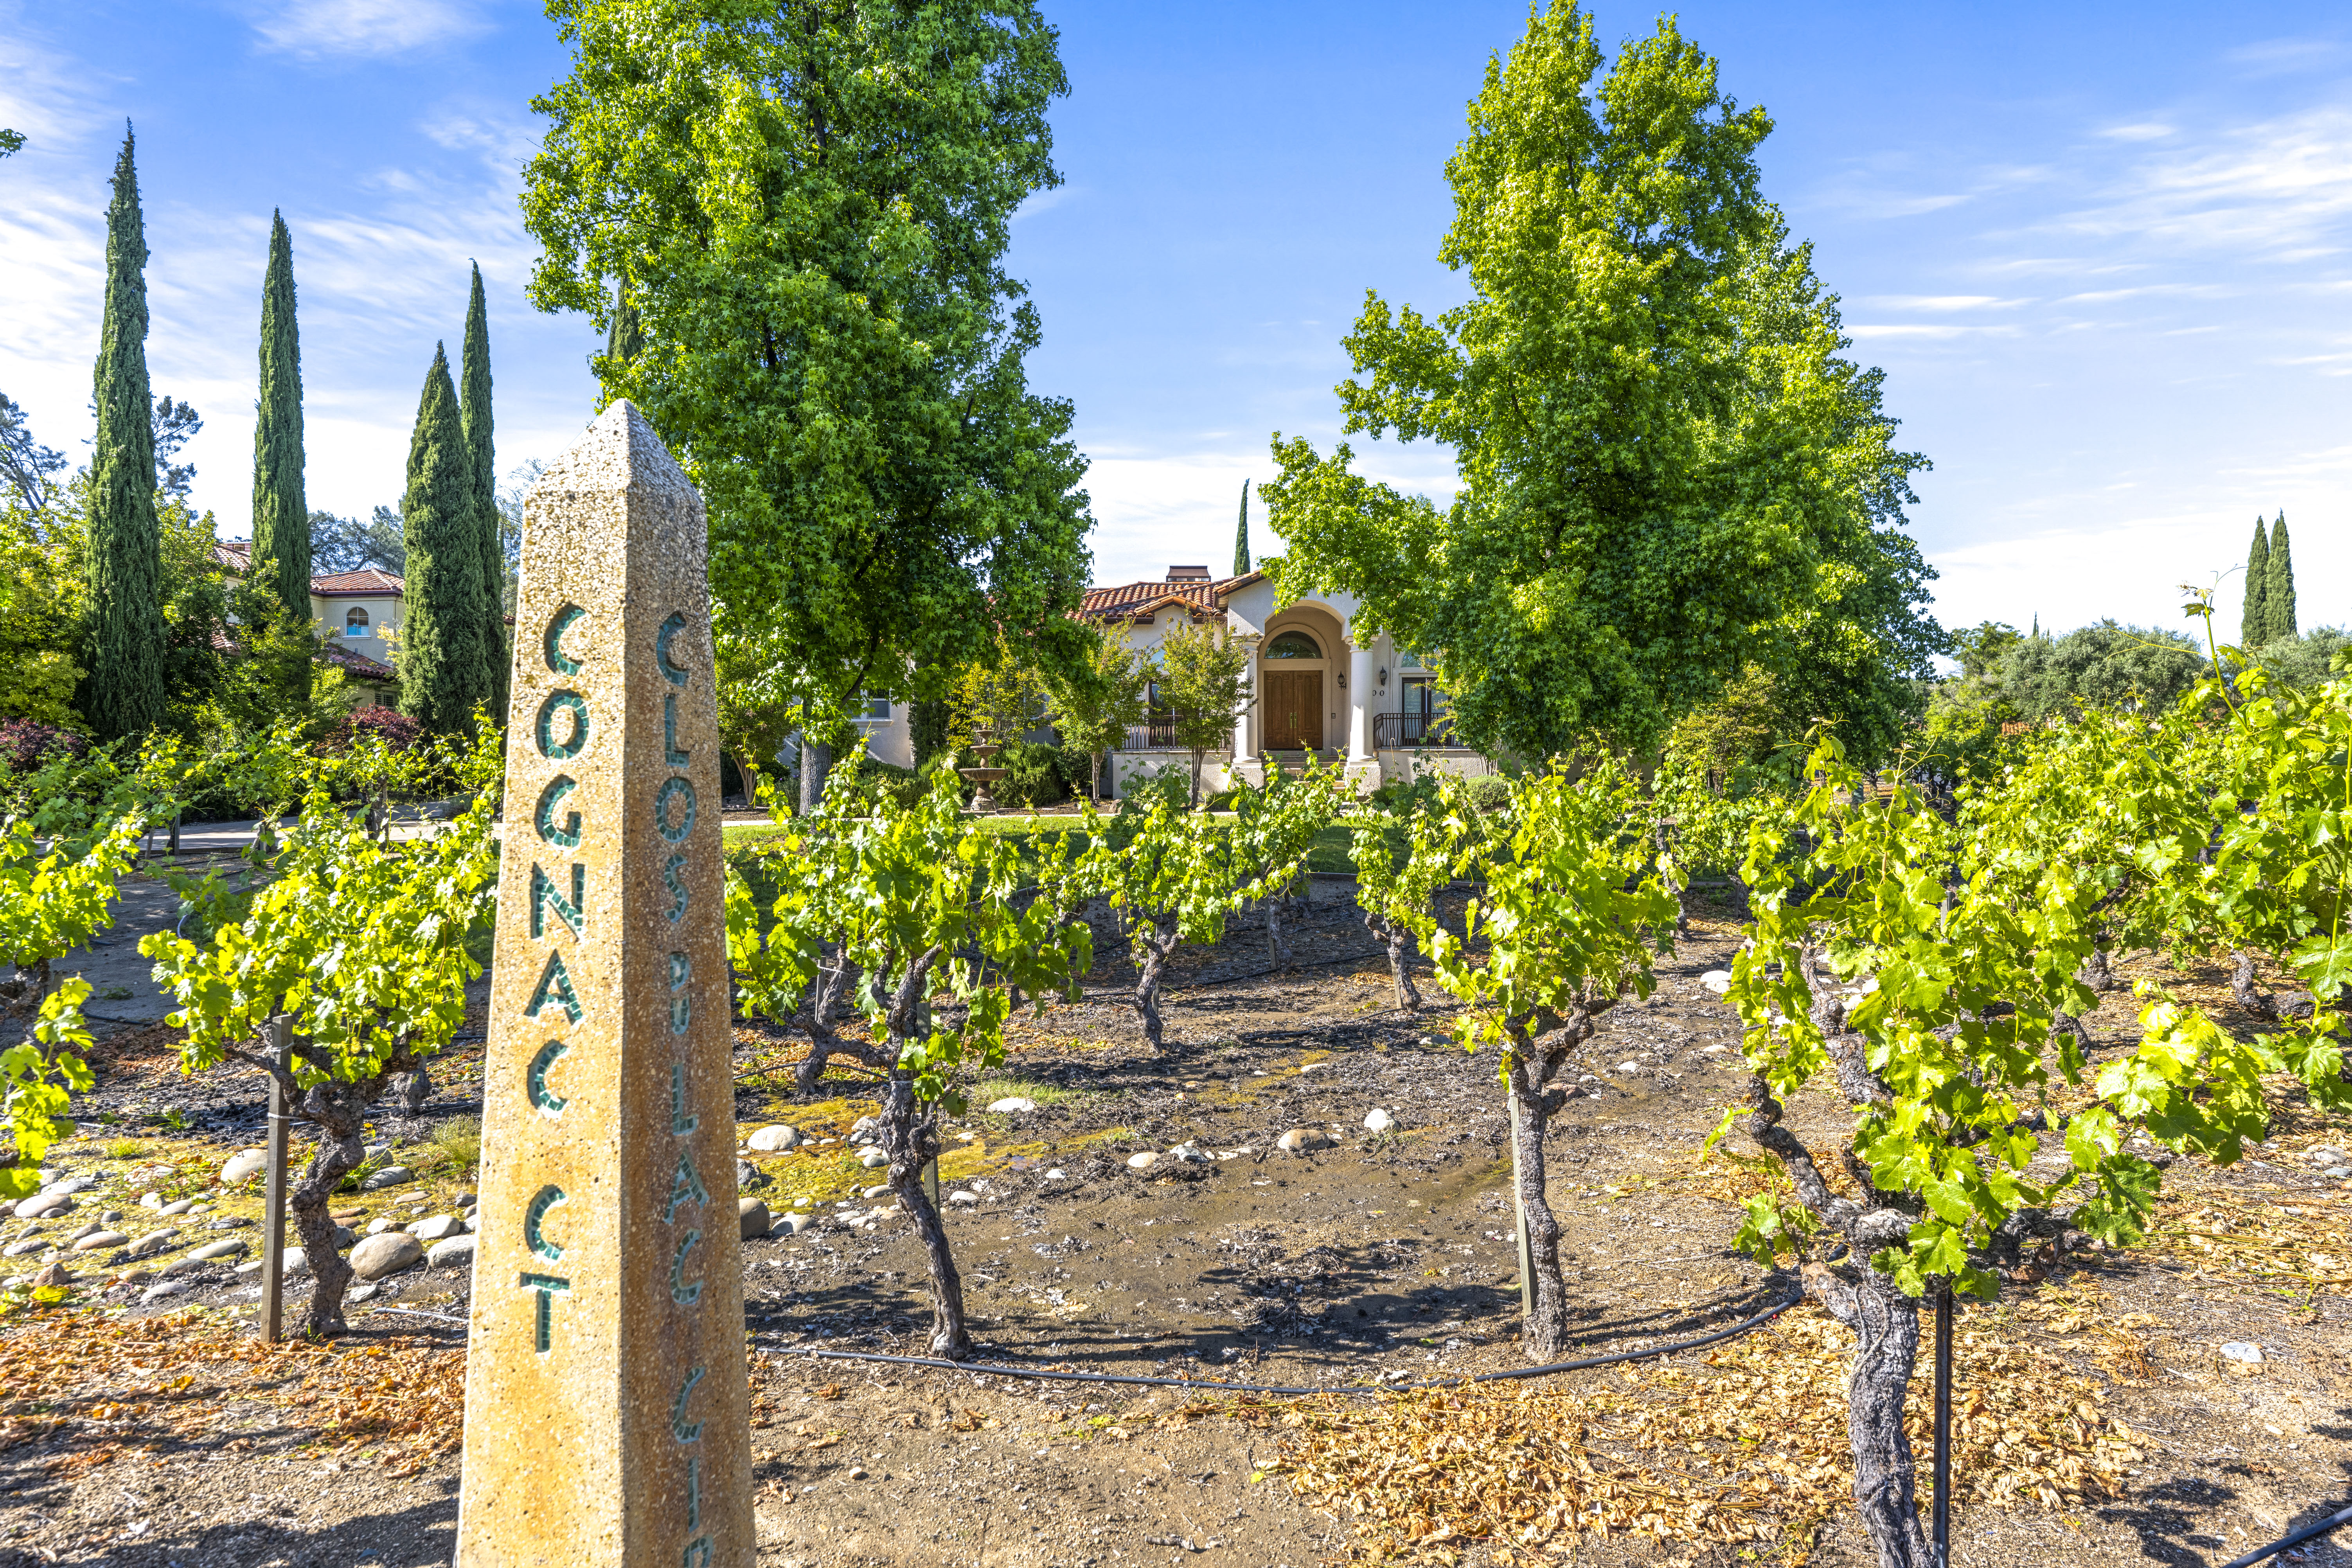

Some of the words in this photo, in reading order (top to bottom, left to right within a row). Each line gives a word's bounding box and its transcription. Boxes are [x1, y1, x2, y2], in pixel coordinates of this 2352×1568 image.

[524, 603, 589, 1117] COGNAC
[656, 611, 697, 924] CLOS
[669, 951, 690, 1035] DU
[520, 1185, 570, 1354] CT
[663, 1063, 710, 1305] LAC
